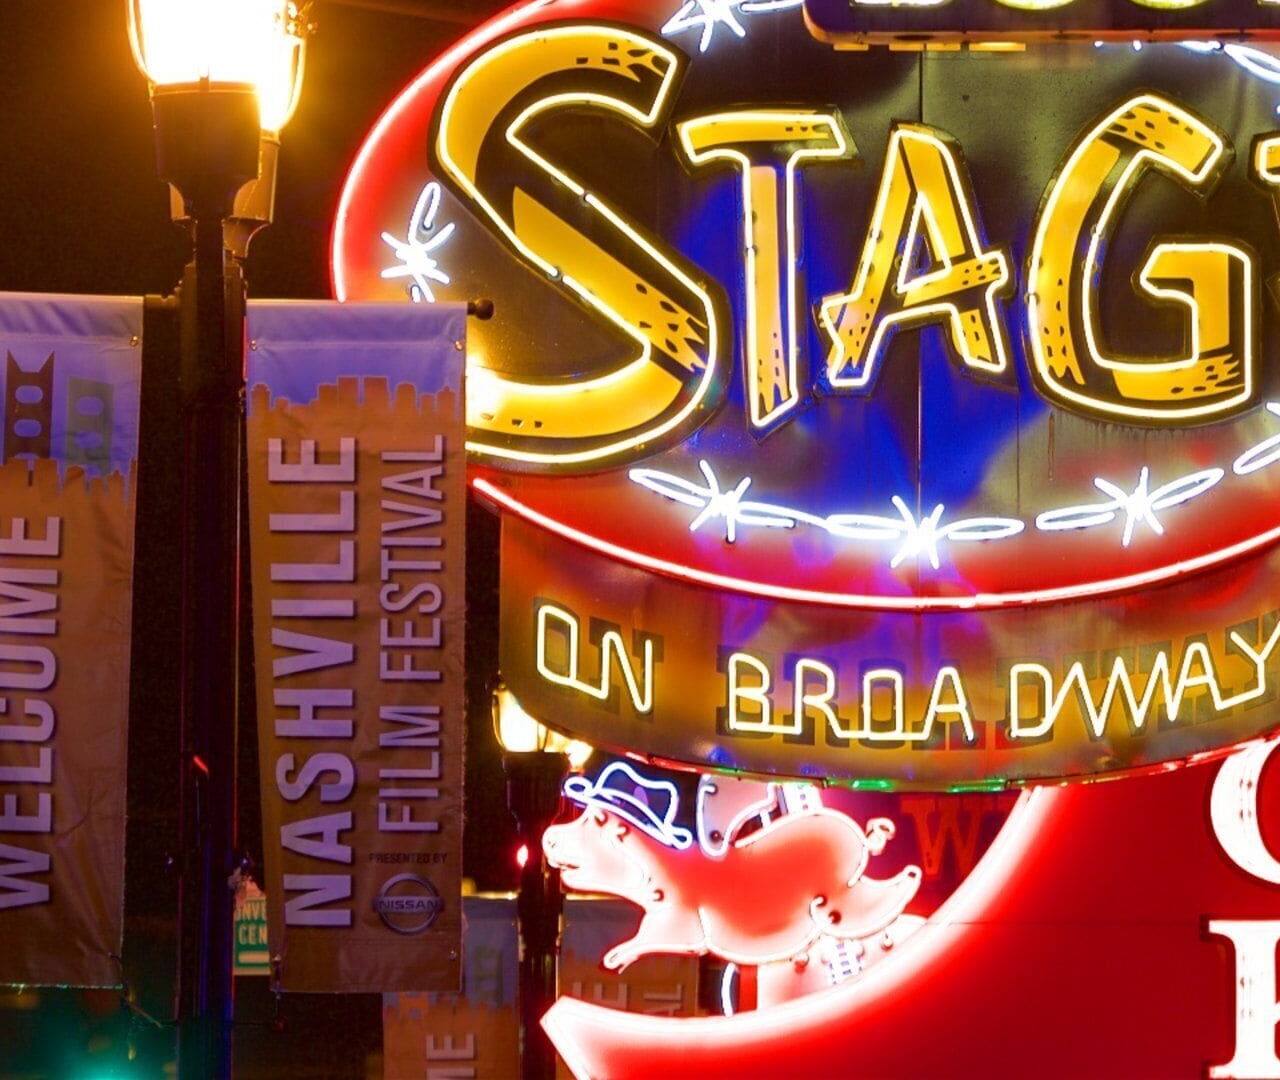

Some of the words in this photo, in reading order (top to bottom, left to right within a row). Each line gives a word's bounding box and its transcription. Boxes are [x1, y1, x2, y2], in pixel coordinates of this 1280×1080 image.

[378, 433, 446, 681] FESTIVAL
[267, 436, 358, 927] NASHVILLE
[534, 604, 662, 714] ON
[378, 704, 441, 834] FILM
[378, 900, 438, 911] NISSAN
